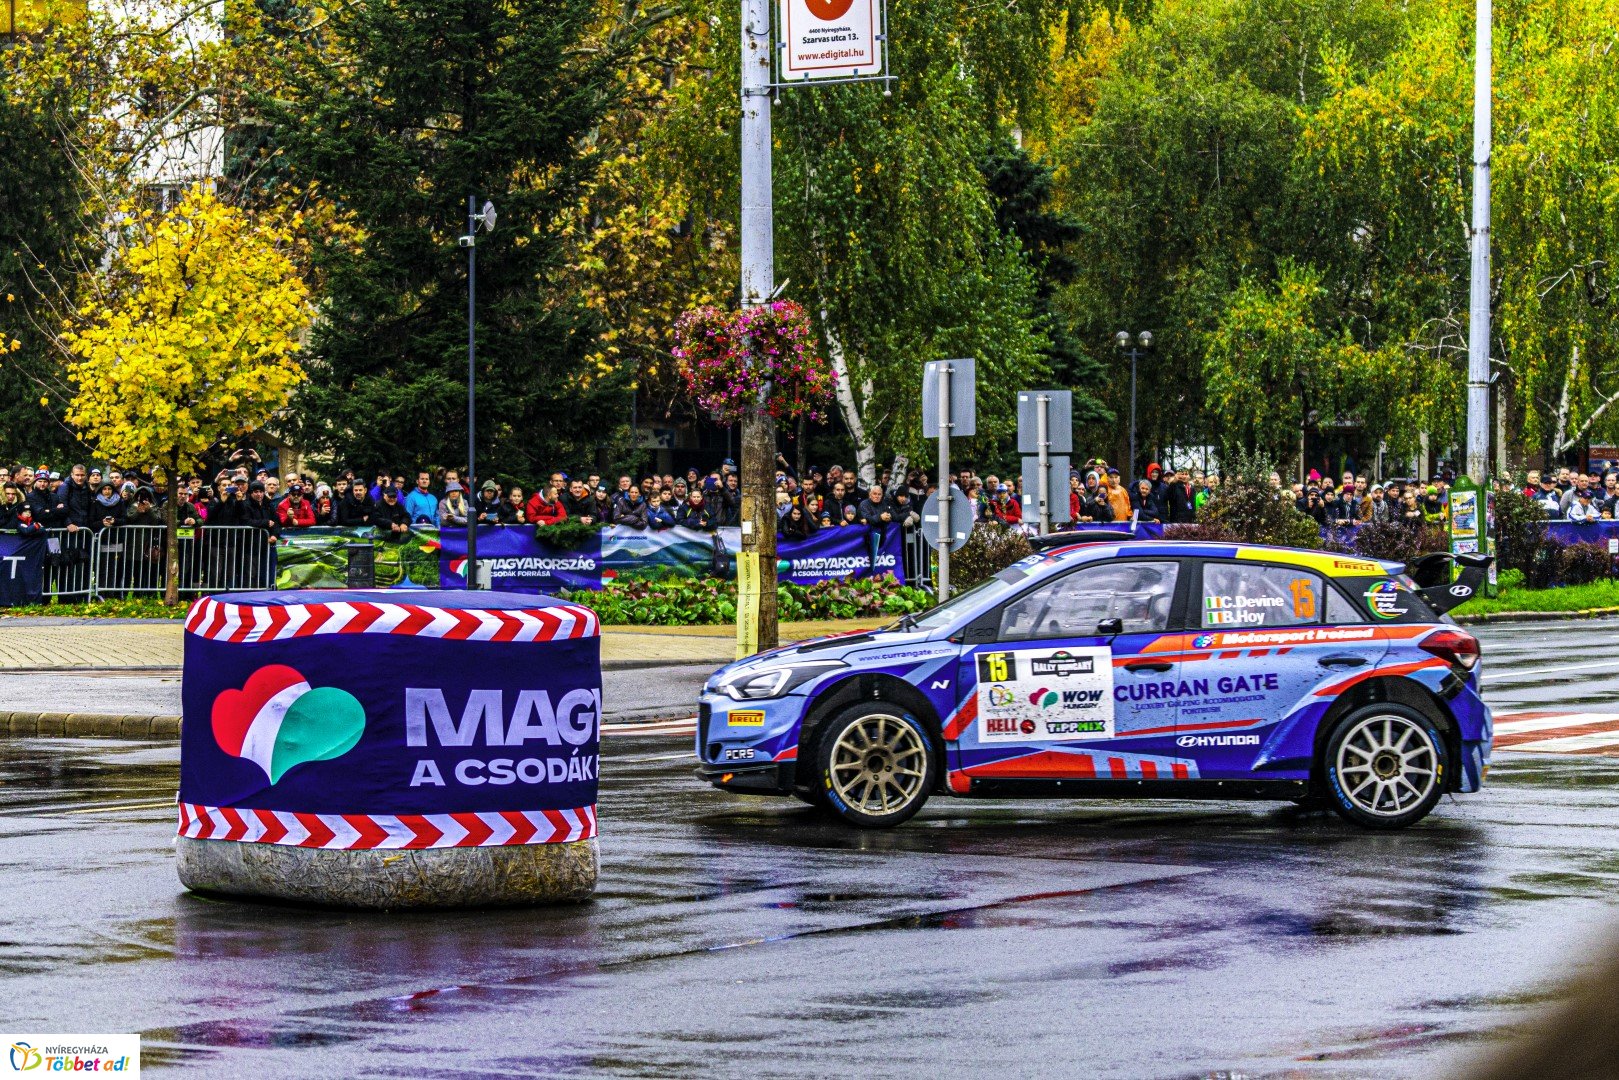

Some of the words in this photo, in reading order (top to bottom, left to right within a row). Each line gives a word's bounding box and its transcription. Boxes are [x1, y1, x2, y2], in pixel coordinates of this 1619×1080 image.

[802, 36, 830, 44] Szarvas
[848, 33, 859, 41] 13.
[798, 48, 865, 61] www.edigital.hu
[1334, 560, 1375, 571] PIRELLI
[517, 569, 551, 577] FORRÁSA
[1221, 594, 1284, 609] C.Devine
[1289, 578, 1316, 619] 15
[1222, 610, 1266, 625] B.Hoy
[1221, 630, 1315, 645] Motorsport
[1315, 627, 1375, 641] Ireland
[858, 647, 952, 662] www.currangate.com
[986, 653, 1008, 682] 15
[1113, 678, 1210, 702] CURRAN
[1217, 673, 1279, 694] GATE
[1063, 690, 1105, 702] WOW
[729, 712, 764, 723] PIRELLI
[986, 718, 1019, 732] HELL
[1198, 735, 1260, 746] HYUNDAI
[725, 748, 755, 760] PCRS
[410, 759, 446, 787] A
[454, 747, 594, 786] CSODÁK
